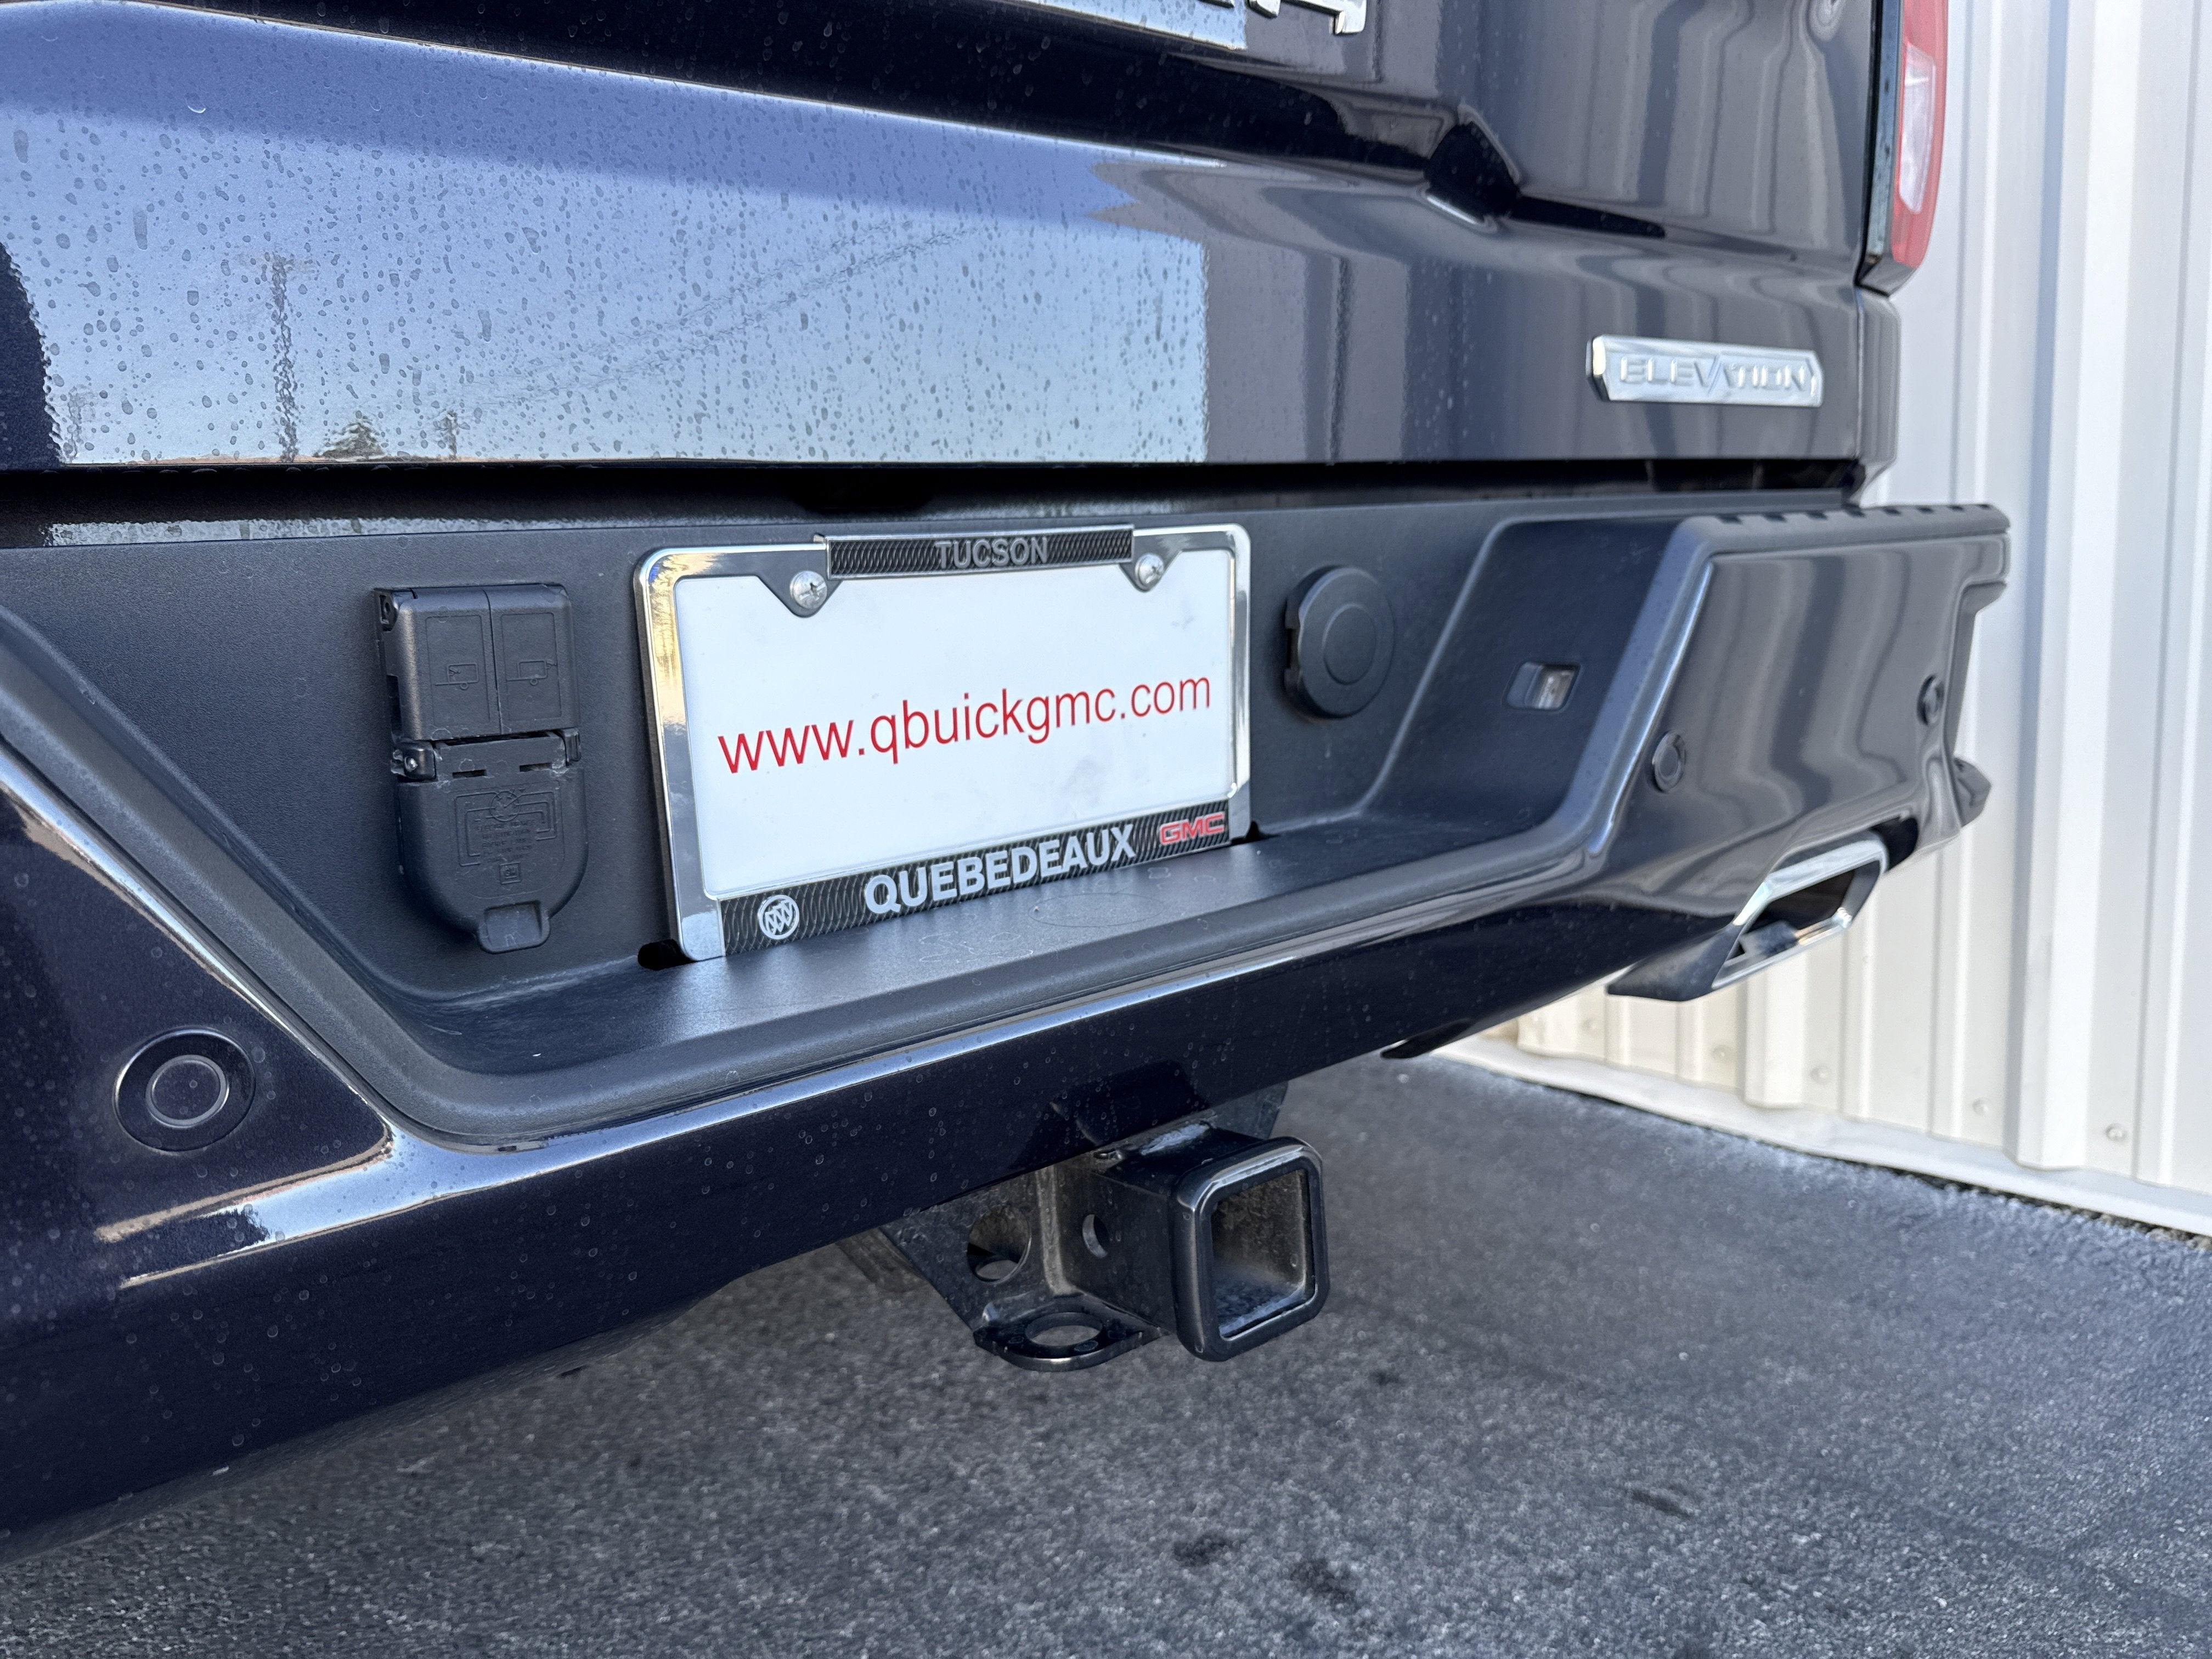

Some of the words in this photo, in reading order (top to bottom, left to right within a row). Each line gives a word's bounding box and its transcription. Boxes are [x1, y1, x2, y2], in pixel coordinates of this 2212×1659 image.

[1620, 356, 1806, 393] ELEVATION
[935, 536, 1048, 569] TUCSON
[718, 677, 1210, 773] www.qbuickgmc.com
[1159, 812, 1224, 845] GMC
[864, 823, 1135, 914] QUEBEDEAUX
